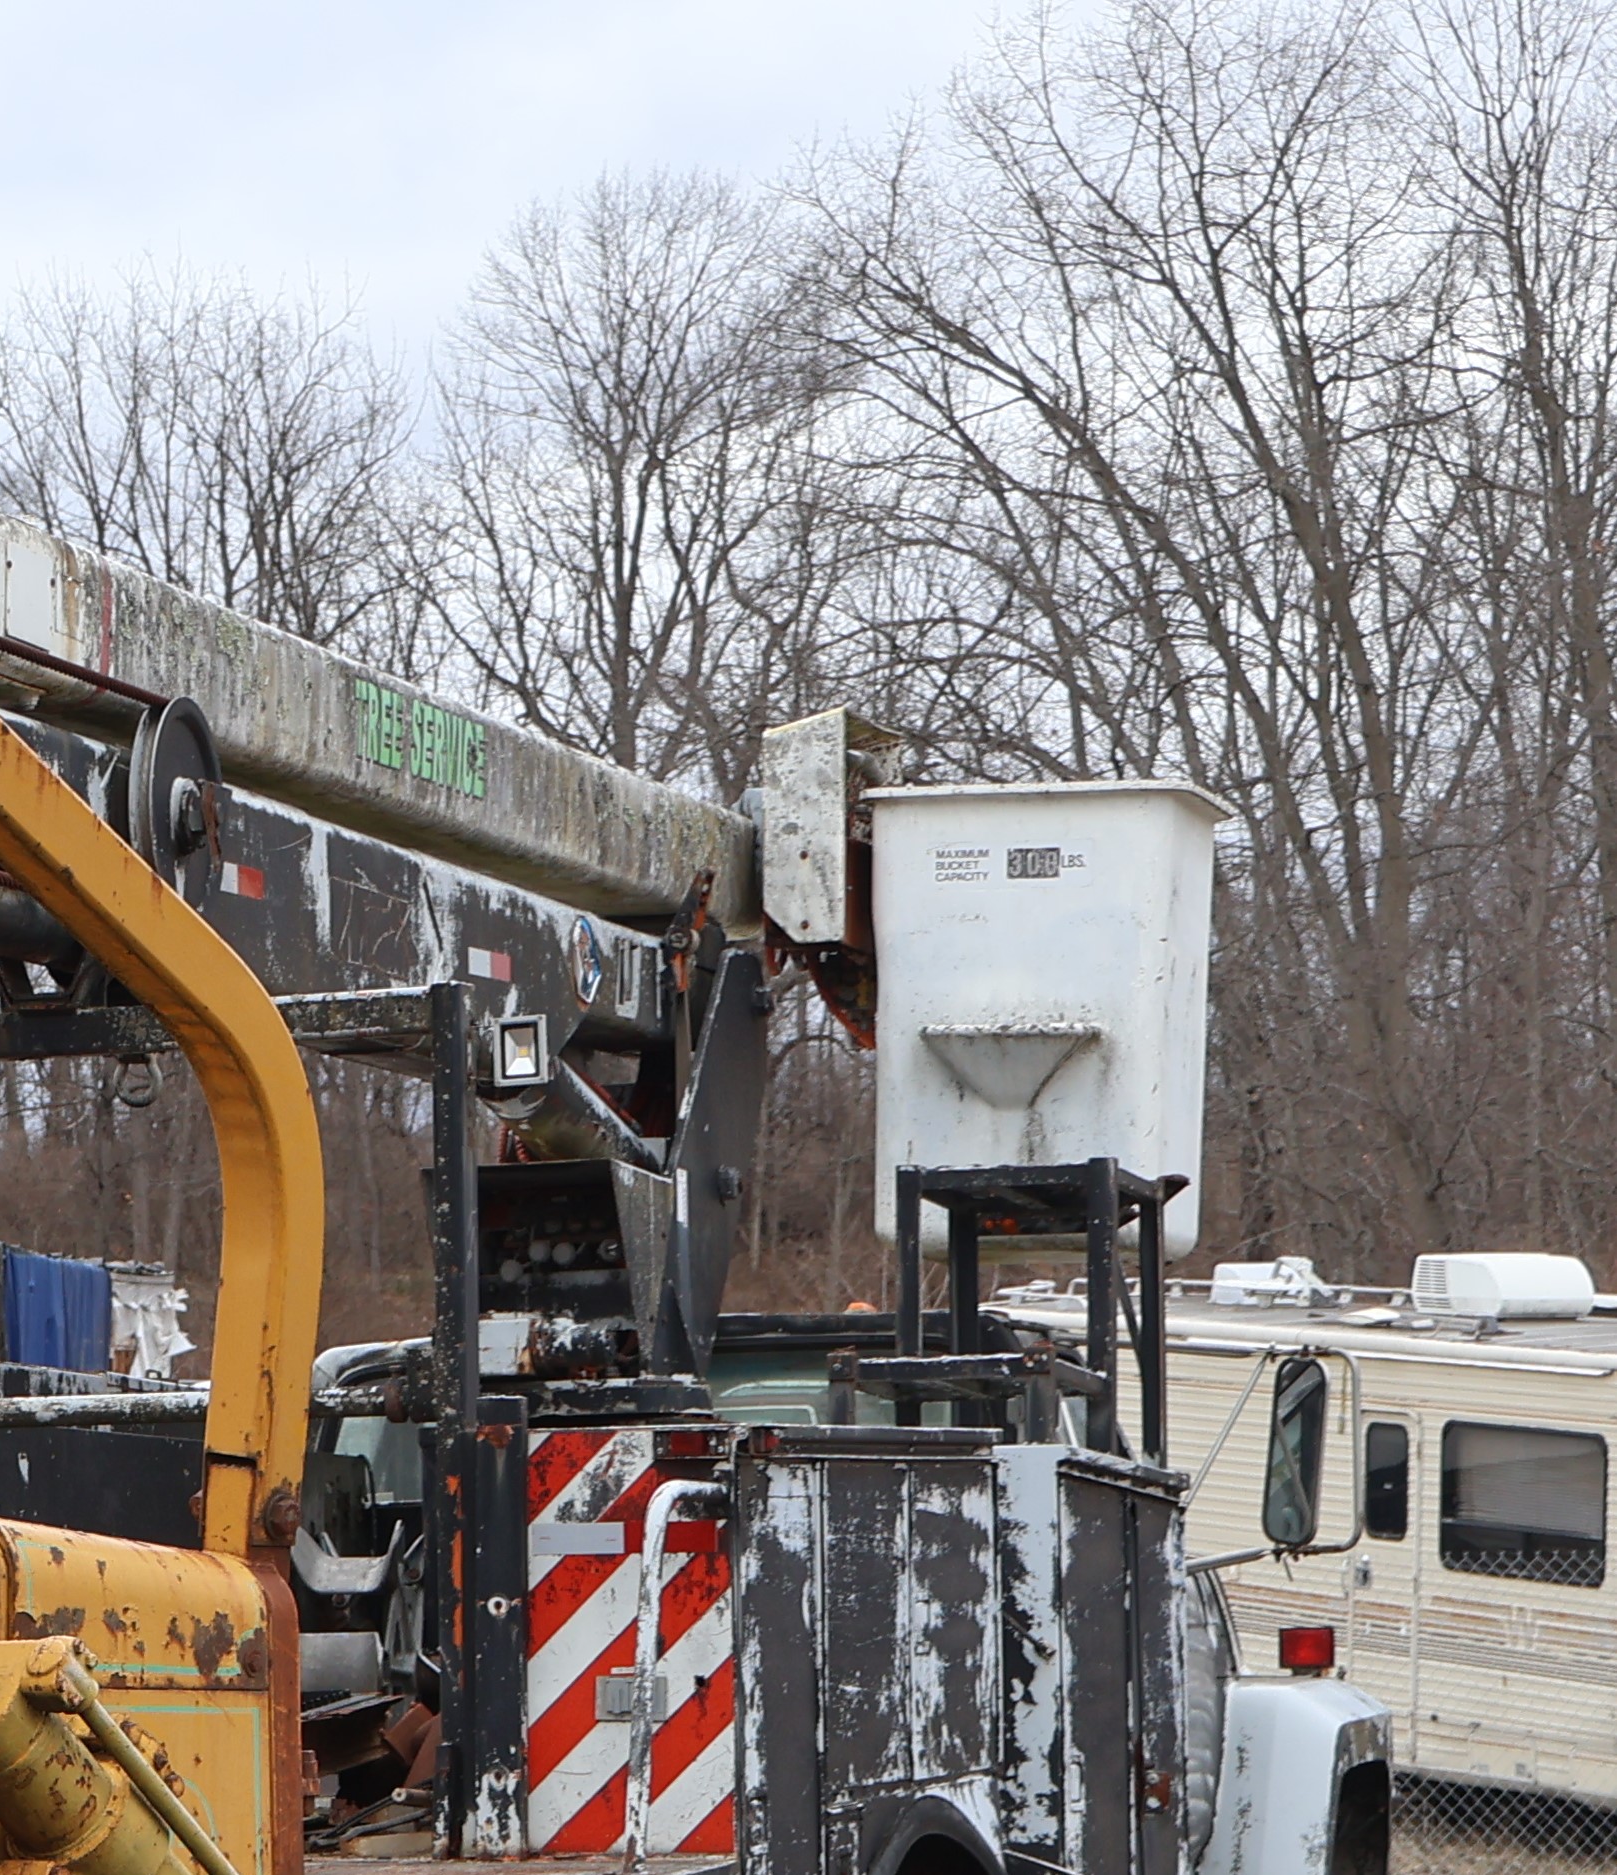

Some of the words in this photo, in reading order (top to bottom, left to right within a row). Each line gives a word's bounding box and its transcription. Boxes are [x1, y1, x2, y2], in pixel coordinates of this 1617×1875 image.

[355, 678, 403, 769] TREE
[410, 699, 487, 799] SERVICE
[935, 849, 990, 859] MAXIMUM
[935, 861, 980, 870] BUCKET
[935, 872, 989, 882] CAPACITY
